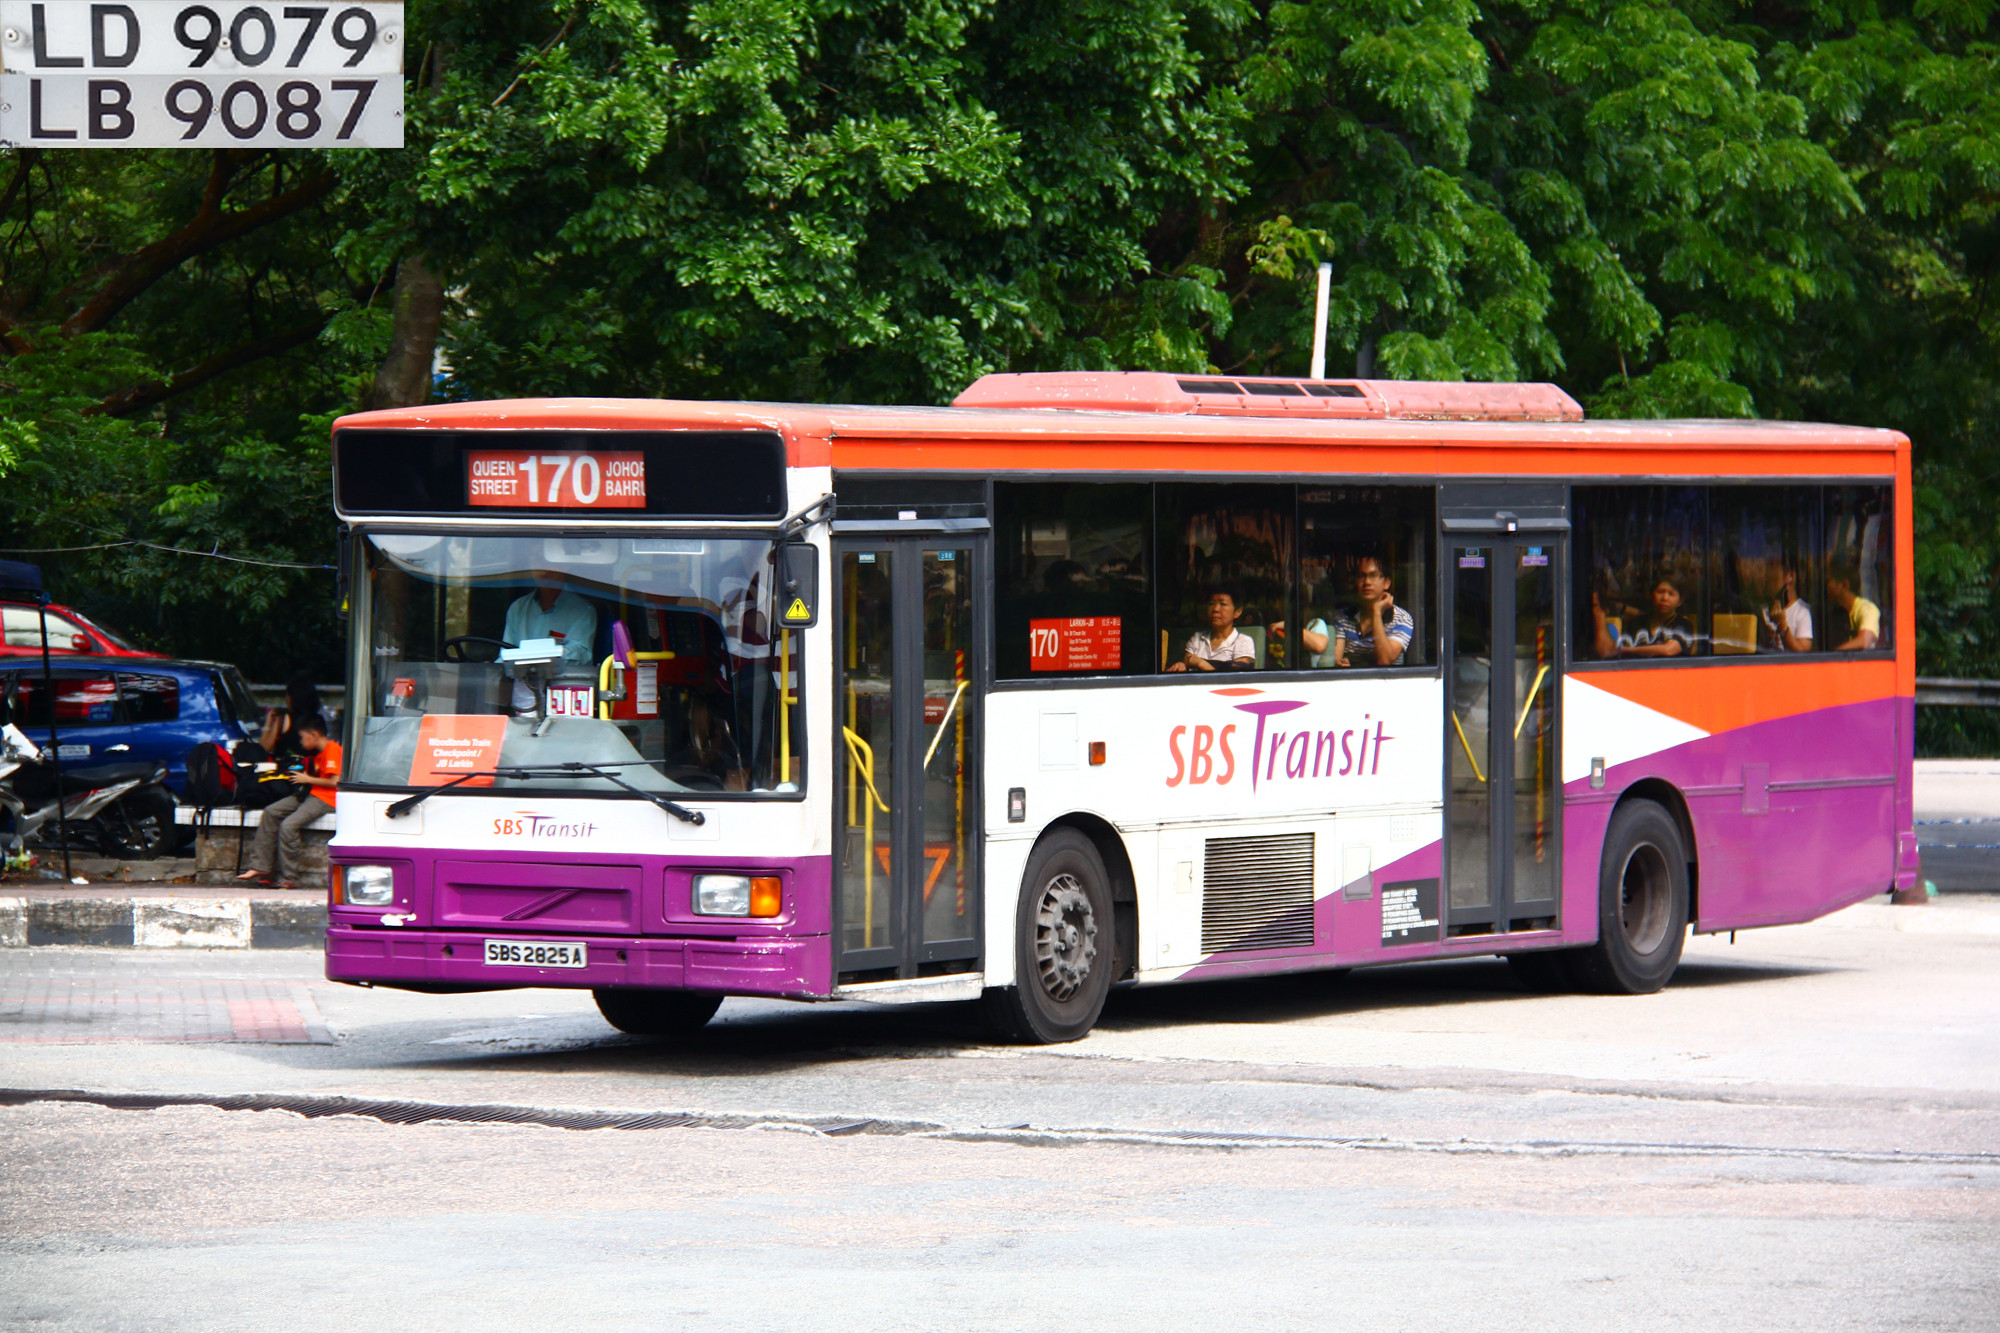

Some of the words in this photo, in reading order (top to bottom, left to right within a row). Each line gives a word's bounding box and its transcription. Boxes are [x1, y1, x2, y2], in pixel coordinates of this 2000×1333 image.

[473, 461, 515, 476] QUEEN
[471, 480, 518, 495] STREET
[519, 455, 600, 504] 170
[1030, 629, 1059, 657] 170
[428, 738, 470, 747] Woodlands
[472, 738, 491, 747] Train
[1166, 724, 1236, 788] SBS
[1232, 700, 1396, 797] Transit
[433, 749, 477, 758] Checkpoint
[448, 760, 473, 768] Larkin
[493, 819, 523, 836] SBS
[521, 815, 599, 838] Transit
[488, 944, 582, 965] SBS2825A
